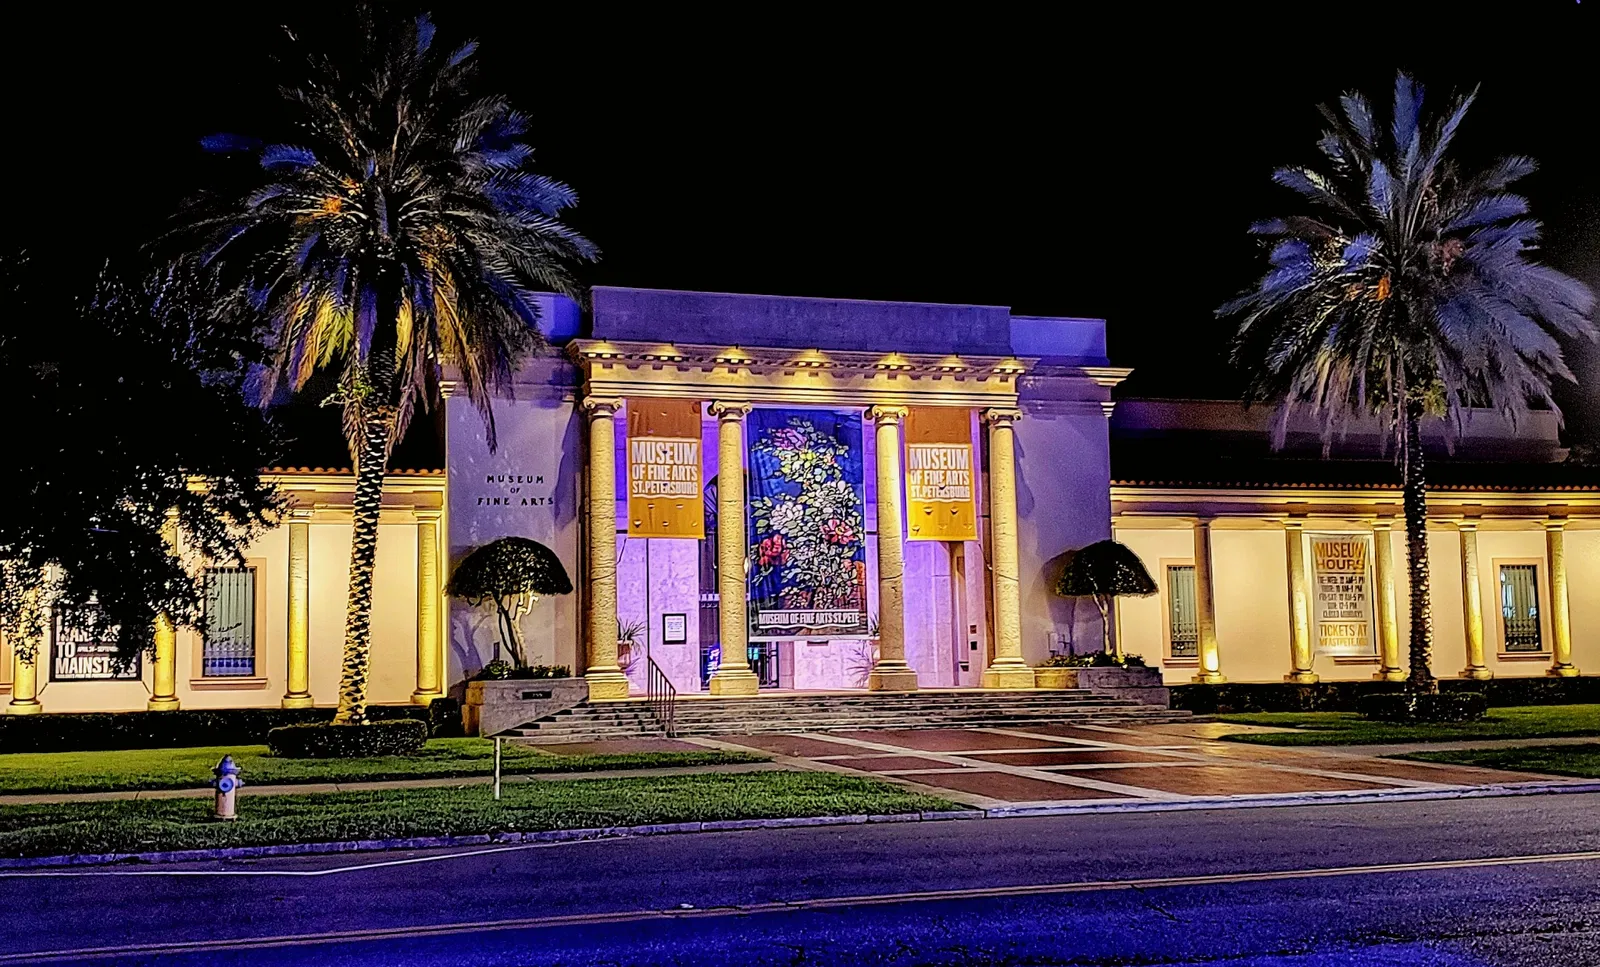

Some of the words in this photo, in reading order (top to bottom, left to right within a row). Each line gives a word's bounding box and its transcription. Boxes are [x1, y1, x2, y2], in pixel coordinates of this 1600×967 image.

[632, 441, 698, 465] MUSEUM
[909, 448, 969, 470] MUSEUM
[486, 475, 544, 484] MUSEUM
[632, 464, 646, 480] OF
[647, 464, 671, 480] FINE
[671, 464, 698, 481] ARTS
[910, 470, 923, 485] OF
[923, 470, 946, 485] FINE
[946, 470, 970, 486] ARTS
[477, 497, 510, 506] FINE
[521, 497, 554, 506] ARTS
[1315, 542, 1364, 558] MUSEUM
[1316, 559, 1364, 570] HOURS
[759, 613, 789, 624] MUSEUM
[790, 613, 799, 624] OF
[800, 613, 815, 624] FINE
[1319, 624, 1356, 637] TICKETS
[1357, 624, 1368, 637] AT
[56, 642, 76, 658] TO
[55, 657, 137, 674] MAINSTS
